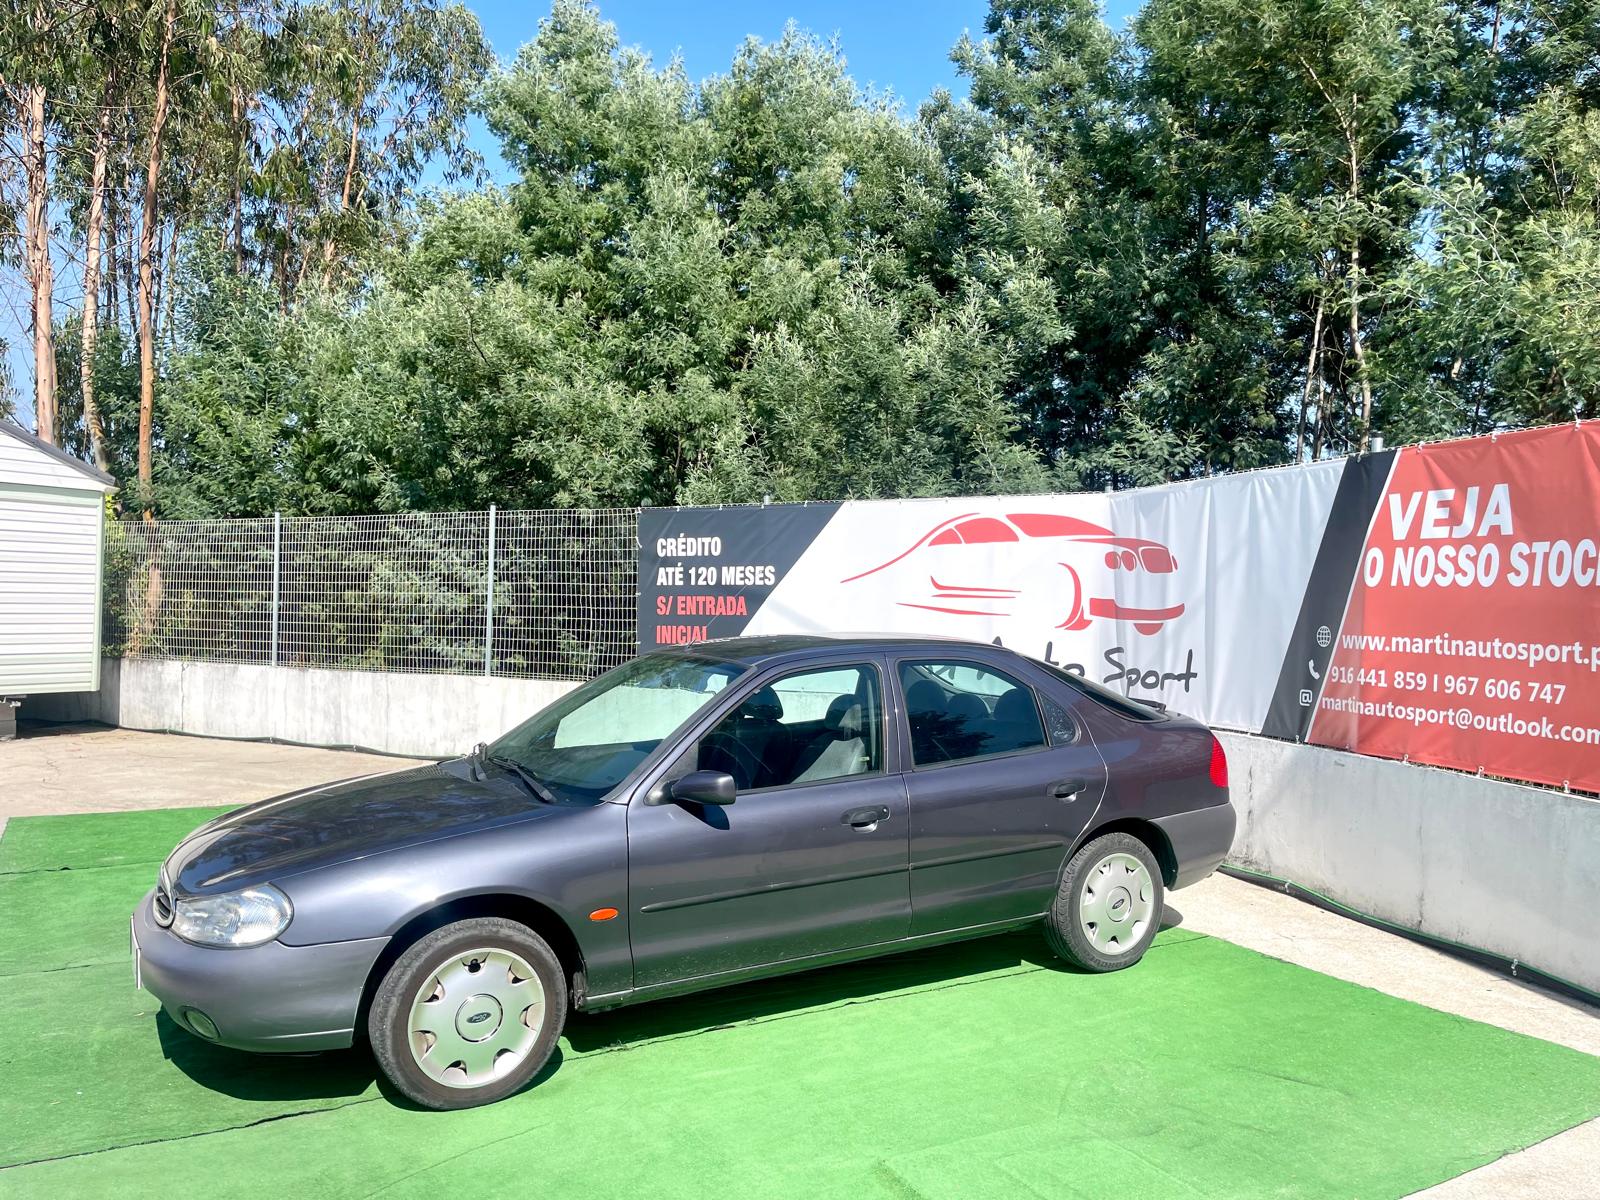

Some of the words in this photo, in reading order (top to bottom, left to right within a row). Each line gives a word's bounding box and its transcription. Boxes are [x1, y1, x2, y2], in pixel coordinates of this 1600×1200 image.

[1389, 483, 1513, 540] VEJA
[656, 532, 722, 557] CRÉDITO
[1364, 547, 1384, 587] O
[1391, 542, 1500, 588] NOSSO
[1507, 538, 1600, 588] STOC
[656, 562, 684, 586] ATÉ
[688, 566, 717, 586] 120
[721, 565, 776, 586] MESES
[656, 595, 674, 616] S/
[677, 595, 748, 616] ENTRADA
[1103, 647, 1197, 698] Sport
[1331, 666, 1354, 684] 916
[1356, 668, 1388, 687] 441
[1393, 671, 1427, 691] 859
[1444, 675, 1479, 696] 967
[1484, 678, 1521, 700] 606
[1527, 682, 1566, 705] 747
